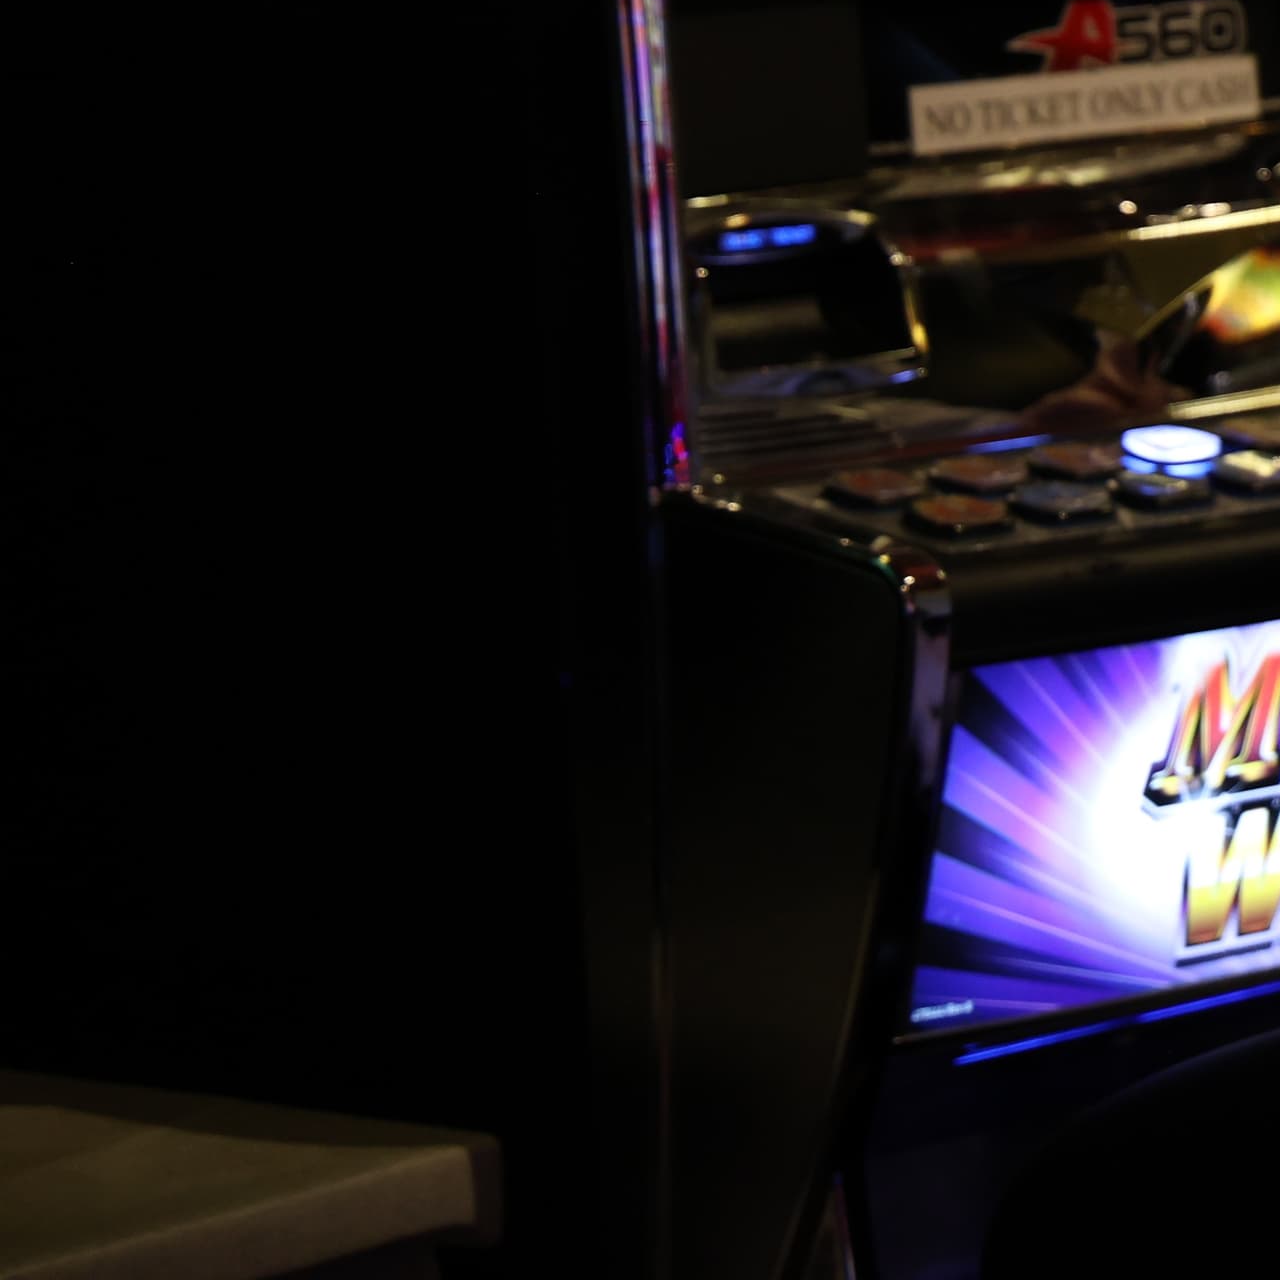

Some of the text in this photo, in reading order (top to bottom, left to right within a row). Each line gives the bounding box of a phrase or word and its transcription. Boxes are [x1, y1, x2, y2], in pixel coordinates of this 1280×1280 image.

[924, 103, 973, 136] NO
[979, 90, 1080, 128] TICKET
[1087, 84, 1163, 118] ONLY
